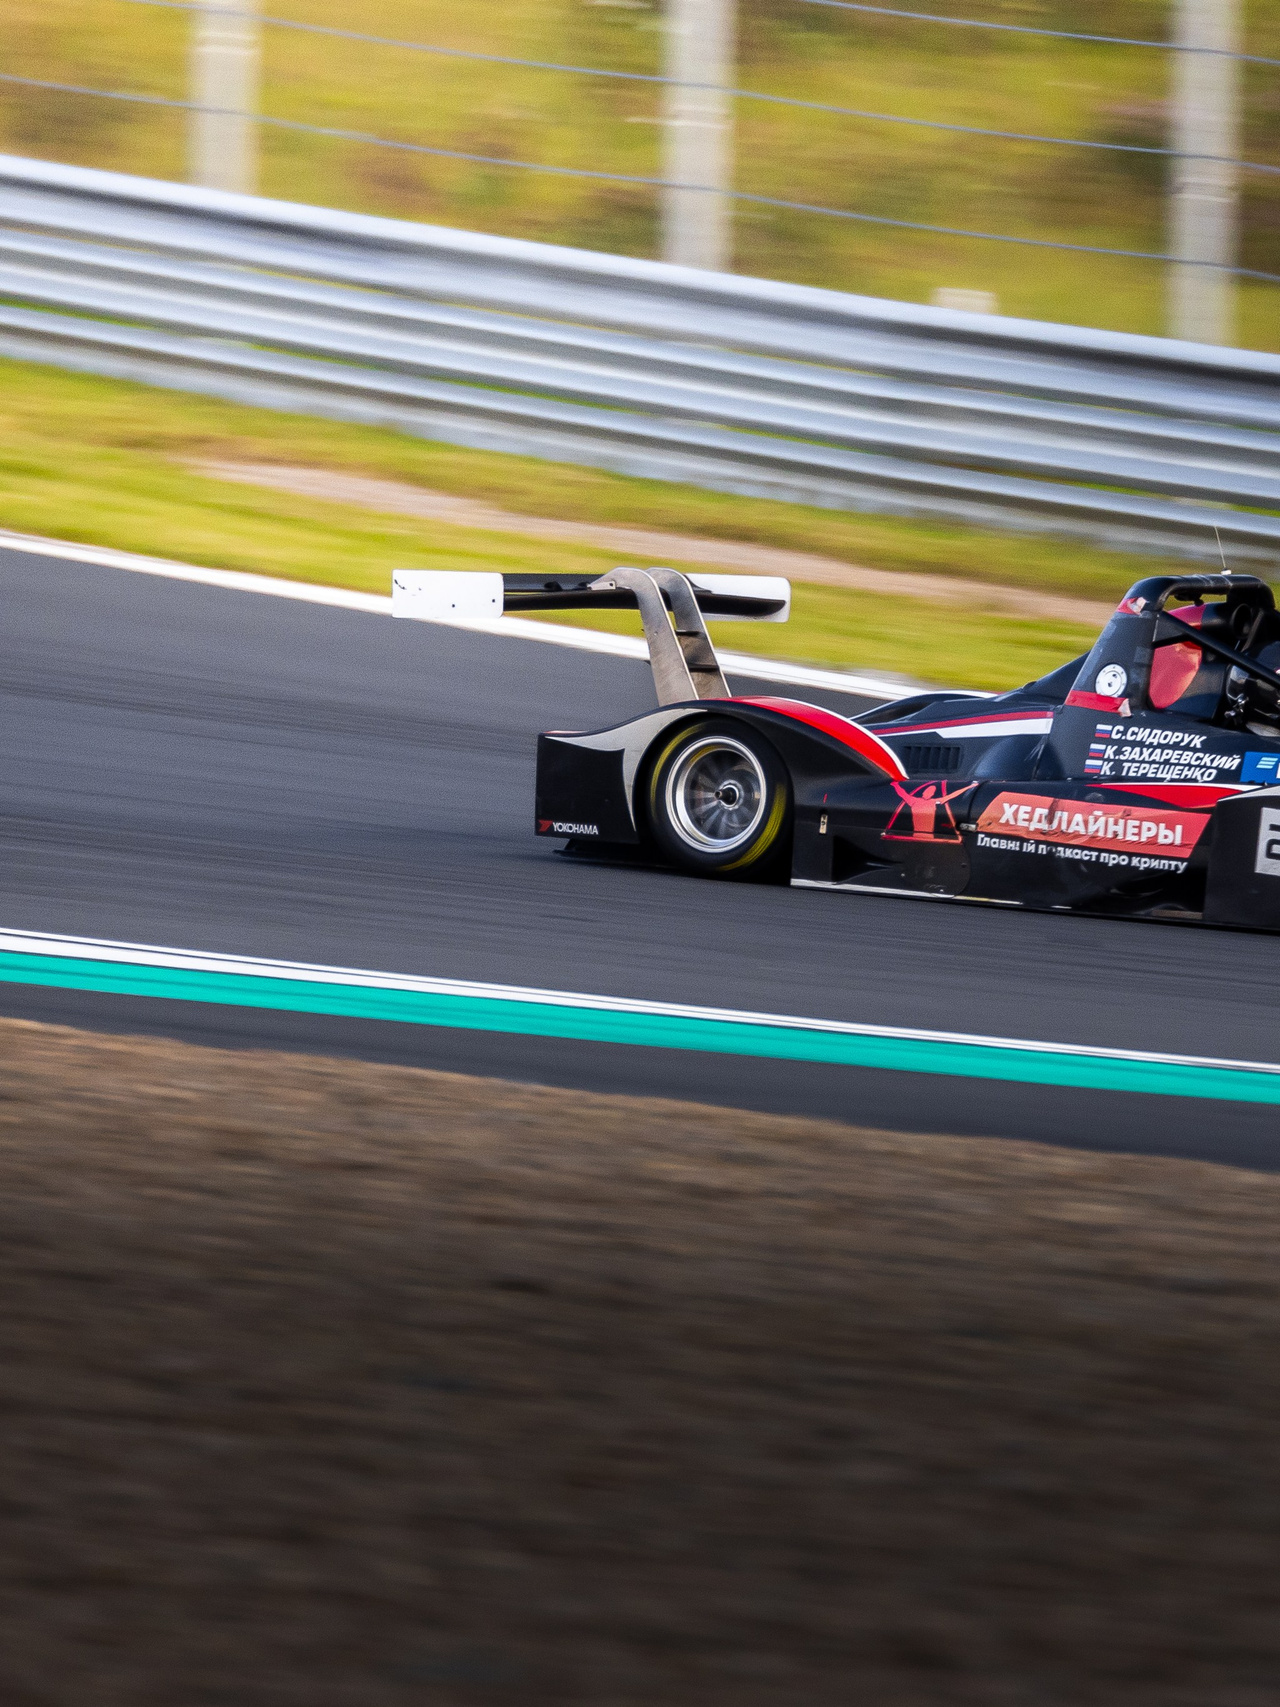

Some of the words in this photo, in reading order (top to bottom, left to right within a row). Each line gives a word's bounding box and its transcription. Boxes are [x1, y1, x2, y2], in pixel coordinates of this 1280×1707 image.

[1111, 725, 1207, 748] С.СИДОРУК
[1104, 745, 1241, 770] К.ЗАХАРЕВСКИЙ
[1121, 762, 1217, 782] ТЕРЕЩЕНКО
[552, 821, 599, 835] YOKOHAMA
[1000, 802, 1183, 846] ХЕДЛАЙНЕРЫ
[1099, 852, 1129, 867] про
[1131, 856, 1188, 874] крипту
